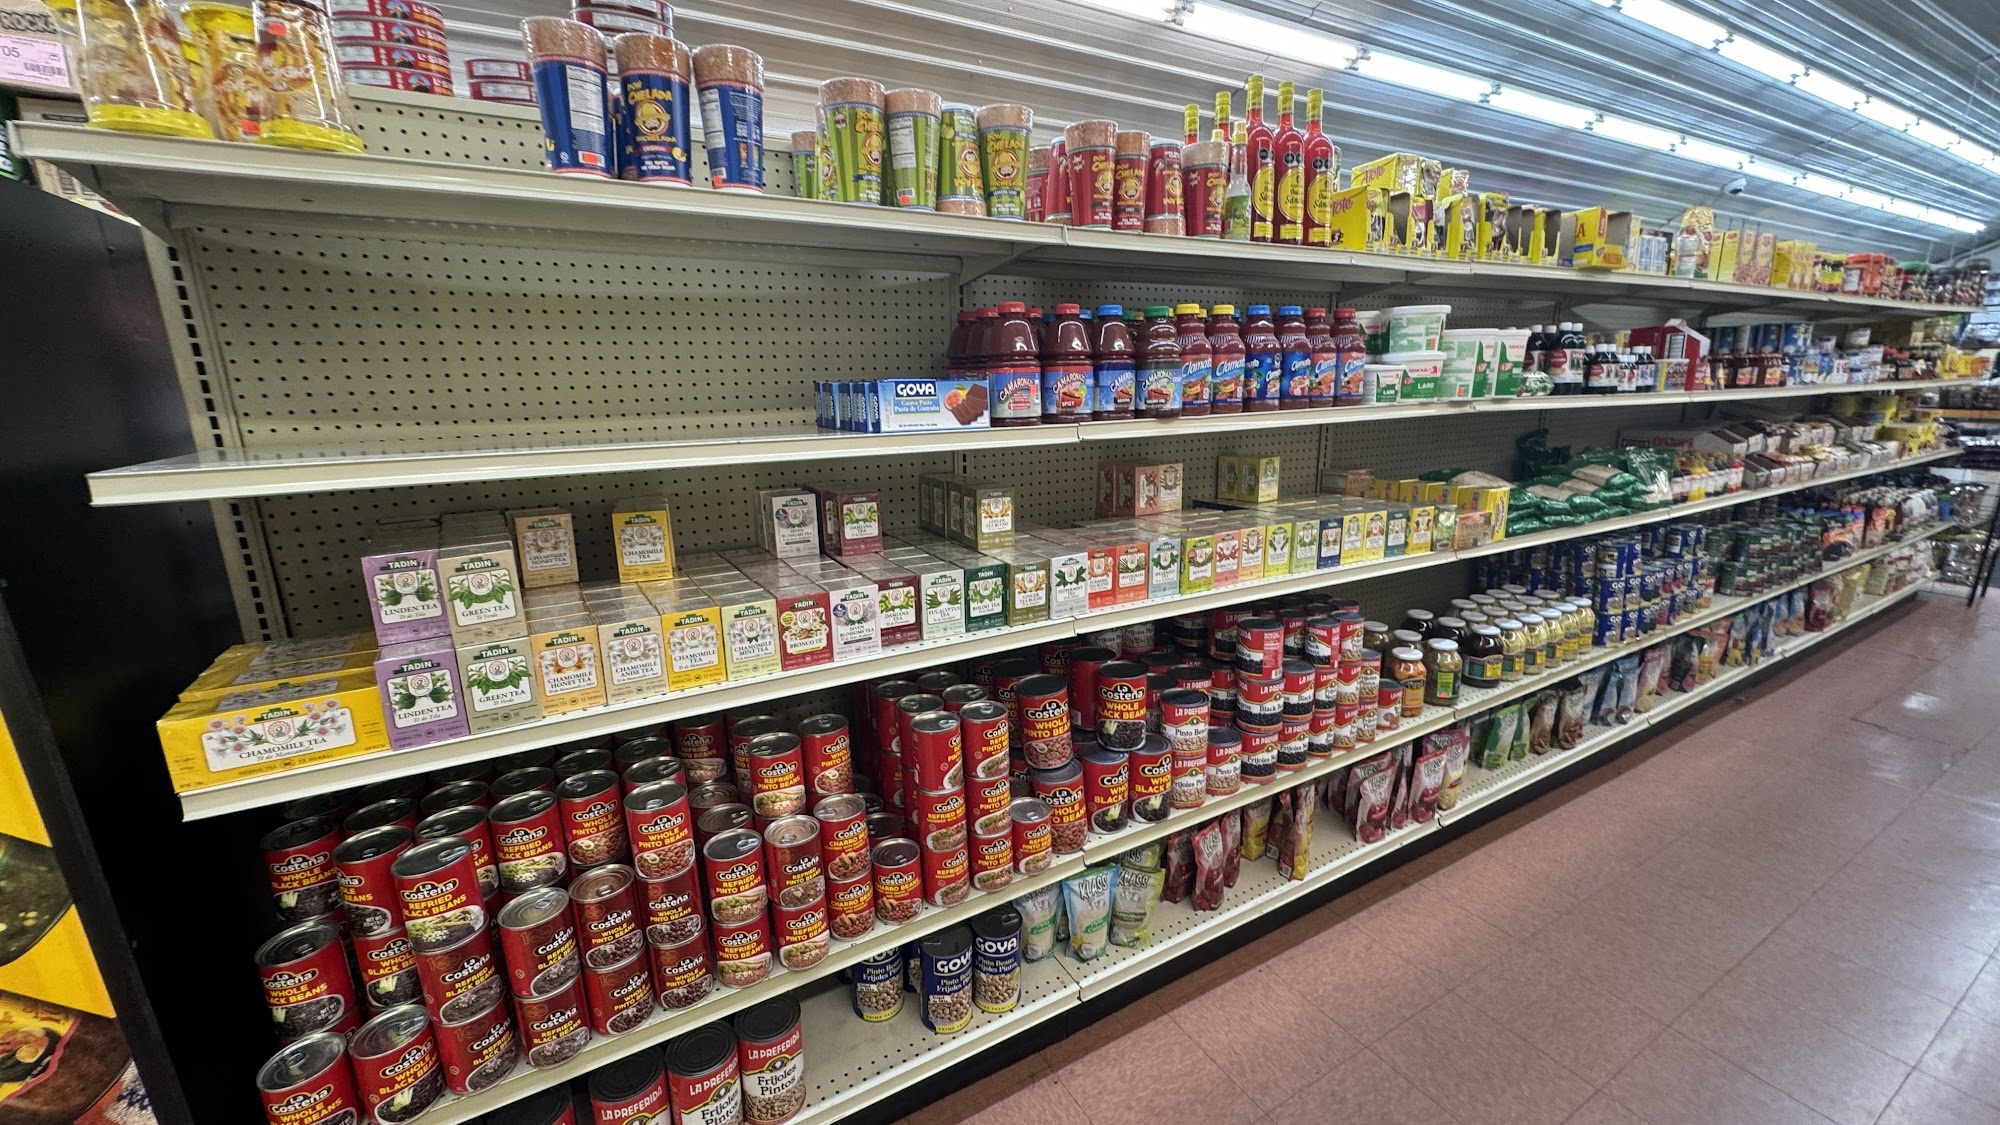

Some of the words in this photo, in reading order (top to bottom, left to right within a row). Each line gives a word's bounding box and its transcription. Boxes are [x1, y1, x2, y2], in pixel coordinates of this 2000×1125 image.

[0, 46, 20, 58] 05
[628, 88, 672, 104] CHELADA
[896, 383, 935, 396] GOYA
[786, 499, 803, 507] TADIN
[630, 516, 651, 524] TADIN
[624, 549, 664, 558] CHAMOMILE
[388, 559, 418, 571] TADIN
[462, 559, 492, 571] TADIN
[934, 576, 953, 584] TADIN
[978, 570, 994, 578] TADIN
[844, 592, 865, 601] TADIN
[384, 606, 418, 616] LINDEN
[419, 603, 438, 612] TEA
[794, 600, 814, 608] TADIN
[972, 604, 990, 613] BOLDO
[461, 608, 488, 618] GREEN
[490, 604, 510, 614] TEA
[739, 607, 761, 617] TADIN
[884, 612, 909, 620] DAMIANA
[680, 616, 704, 625] TADIN
[619, 625, 645, 635] TADIN
[551, 634, 578, 645] TADIN
[480, 647, 509, 659] TADIN
[734, 641, 773, 652] CHAMOMILE
[739, 647, 755, 655] MINT
[673, 650, 717, 661] CHAMOMILE
[401, 659, 433, 672] TADIN
[615, 661, 658, 676] CHAMOMILE
[547, 671, 592, 685] CHAMOMILE
[620, 669, 638, 678] ANISE
[551, 679, 575, 689] HONEY
[577, 675, 592, 684] TEA
[1117, 684, 1128, 692] La
[478, 694, 504, 704] GREEN
[505, 689, 526, 699] TEA
[1101, 687, 1145, 700] Costeña
[398, 708, 433, 720] LINDEN
[434, 704, 453, 713] TEA
[1027, 702, 1068, 719] Costeña
[1046, 702, 1057, 710] La
[1106, 701, 1140, 711] WHOLE
[261, 708, 290, 720] TADIN
[1123, 707, 1147, 719] BEANS
[1034, 716, 1068, 730] WHOLE
[1175, 728, 1193, 737] Pinto
[238, 741, 304, 760] CHAMOMILE
[306, 737, 327, 747] TEA
[1247, 755, 1268, 764] Frijoles
[761, 763, 795, 776] Costeña
[764, 773, 794, 784] REFRIED
[780, 775, 800, 788] BEANS
[641, 816, 682, 833] Costeña
[500, 828, 543, 843] Costeña
[639, 838, 662, 848] PINTO
[664, 829, 688, 845] BEANS
[648, 827, 680, 841] WHOLE
[503, 840, 541, 852] REFRIED
[272, 854, 326, 874] Costeña
[290, 856, 303, 864] La
[281, 867, 321, 882] WHOLE
[719, 862, 758, 879] Costeña
[733, 865, 743, 873] La
[722, 874, 755, 888] REFRIED
[1118, 869, 1149, 888] KLASS
[403, 881, 456, 902] Costeña
[419, 883, 432, 892] La
[716, 885, 737, 894] PINTO
[738, 877, 761, 891] BEANS
[1079, 873, 1108, 899] KLASS
[409, 893, 453, 910] REFRIED
[432, 894, 467, 912] BEANS
[831, 897, 852, 907] CHARRO
[976, 936, 1018, 953] GOYA
[445, 953, 491, 982] Costeña
[463, 958, 476, 968] La
[978, 956, 994, 966] Pinto
[996, 956, 1014, 966] Beans
[1000, 961, 1019, 970] Pintos
[446, 983, 472, 998] BLACK
[473, 966, 495, 987] BEANS
[455, 966, 489, 989] REFRIED
[270, 984, 309, 998] WHOLE
[289, 983, 328, 1003] BEANS
[937, 982, 961, 992] Frijoles
[748, 1047, 760, 1060] La
[760, 1031, 800, 1059] PREFERIDA
[385, 1041, 432, 1075] Costeña
[405, 1048, 417, 1060] La
[394, 1054, 431, 1082] WHOLE
[757, 1064, 797, 1086] Frijoles
[379, 1072, 415, 1095] BLACK
[759, 1076, 796, 1096] Pintos
